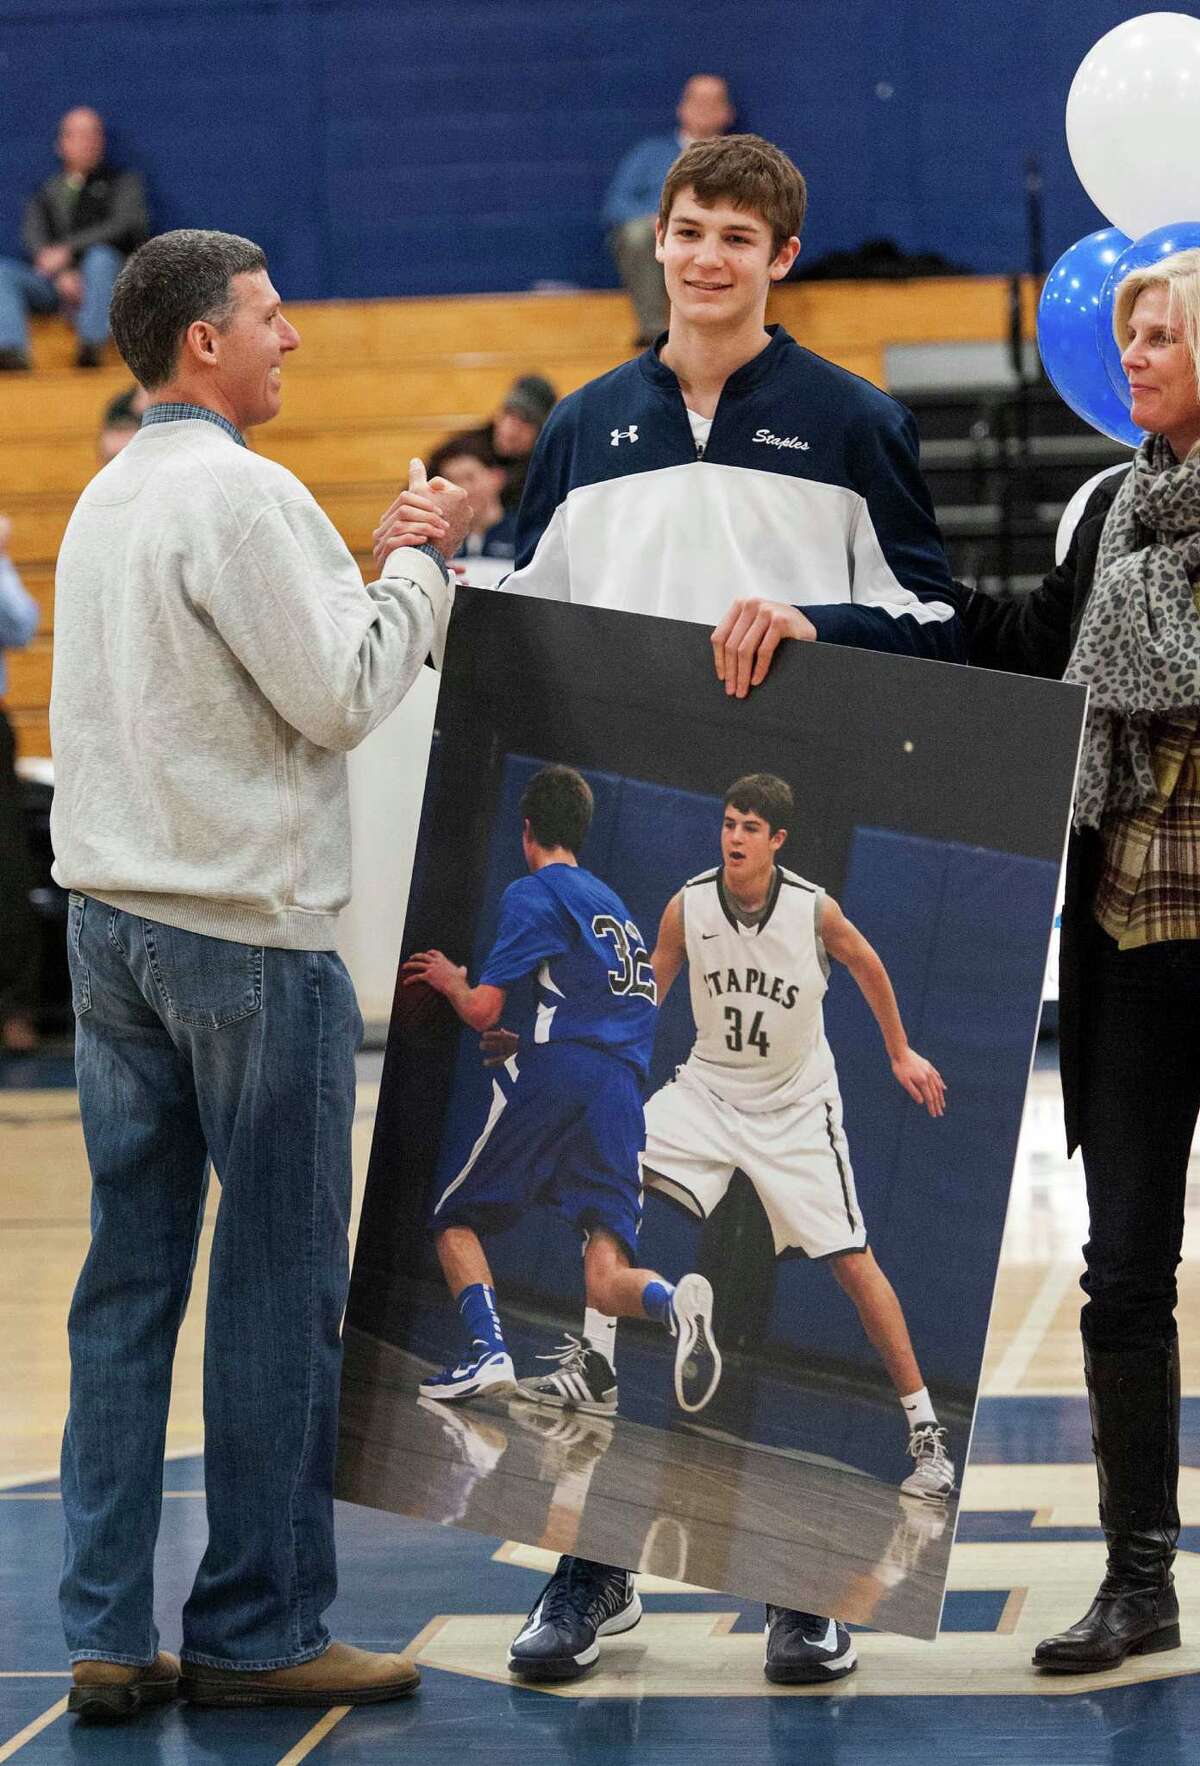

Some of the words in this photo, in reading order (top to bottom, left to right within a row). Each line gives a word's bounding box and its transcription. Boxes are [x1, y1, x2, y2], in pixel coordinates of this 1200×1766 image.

[751, 429, 810, 450] Staples
[591, 915, 657, 1006] 32
[704, 968, 799, 1009] TAPLES
[724, 1006, 770, 1057] 34
